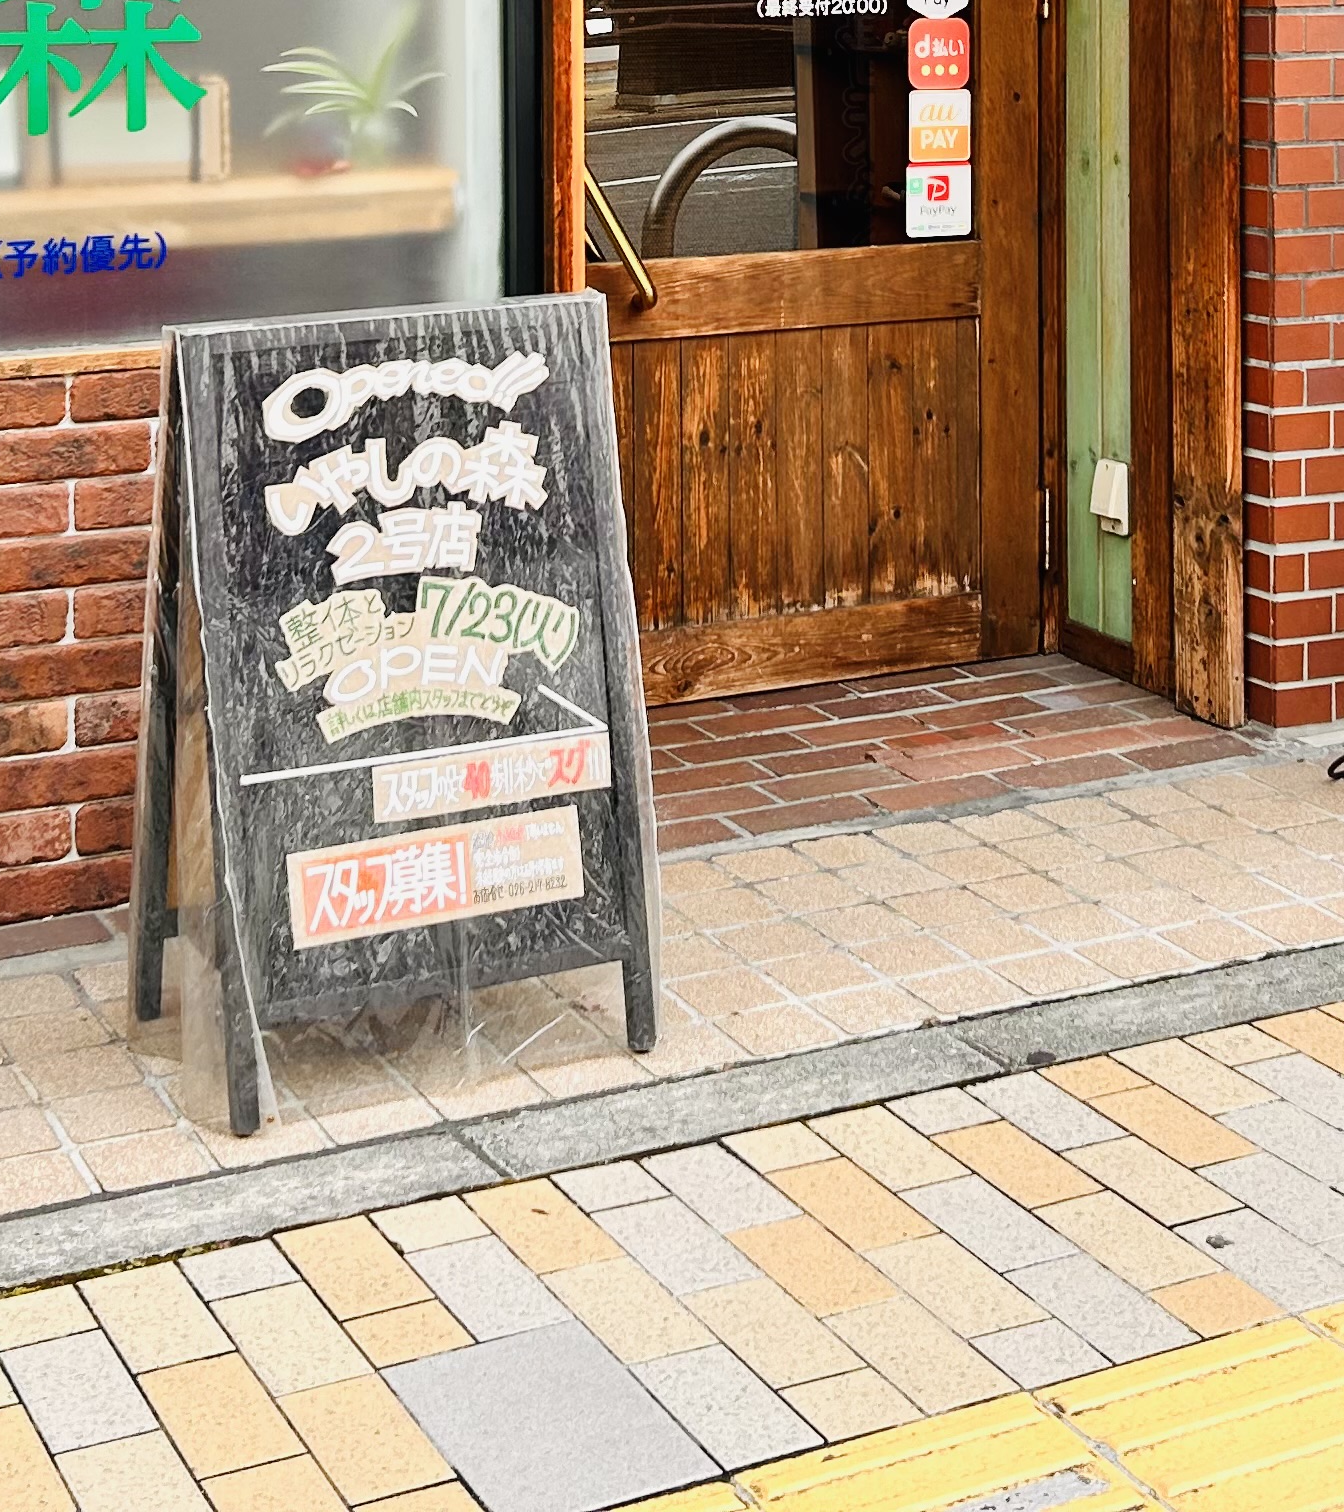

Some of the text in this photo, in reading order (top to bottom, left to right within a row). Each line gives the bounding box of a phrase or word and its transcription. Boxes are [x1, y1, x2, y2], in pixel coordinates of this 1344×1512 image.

[914, 34, 965, 59] d払い
[918, 102, 959, 123] au
[920, 129, 959, 150] PAY
[269, 424, 544, 532] いやしの森
[330, 503, 478, 579] 2号店
[282, 616, 415, 687] リラクゼーション
[286, 593, 382, 652] 整体と
[421, 581, 575, 666] 7/23(火)
[329, 644, 504, 703] OPEN
[306, 840, 468, 932] スタッフ募集!
